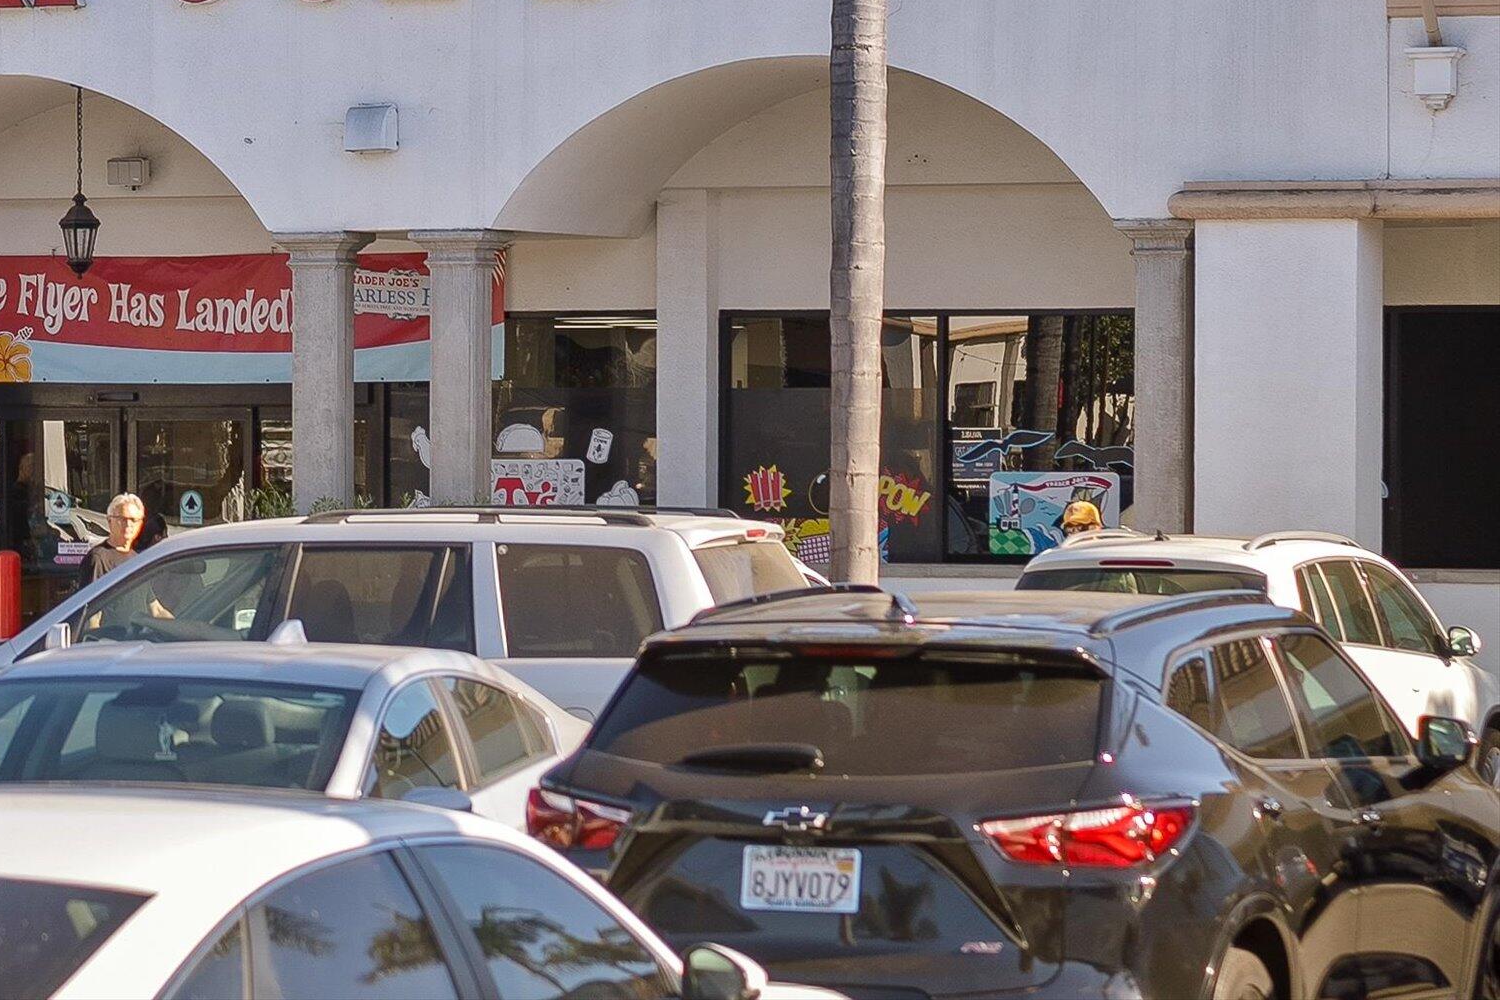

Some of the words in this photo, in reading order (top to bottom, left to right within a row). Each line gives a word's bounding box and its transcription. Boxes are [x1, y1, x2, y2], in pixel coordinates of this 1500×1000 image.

[353, 275, 385, 287] RADER
[388, 277, 420, 288] JOE'S
[353, 288, 416, 306] ARLESS
[16, 272, 98, 335] Flyer
[107, 282, 165, 328] Has
[175, 288, 293, 335] Landed
[878, 474, 932, 517] POW
[750, 870, 851, 904] 8JYV079
